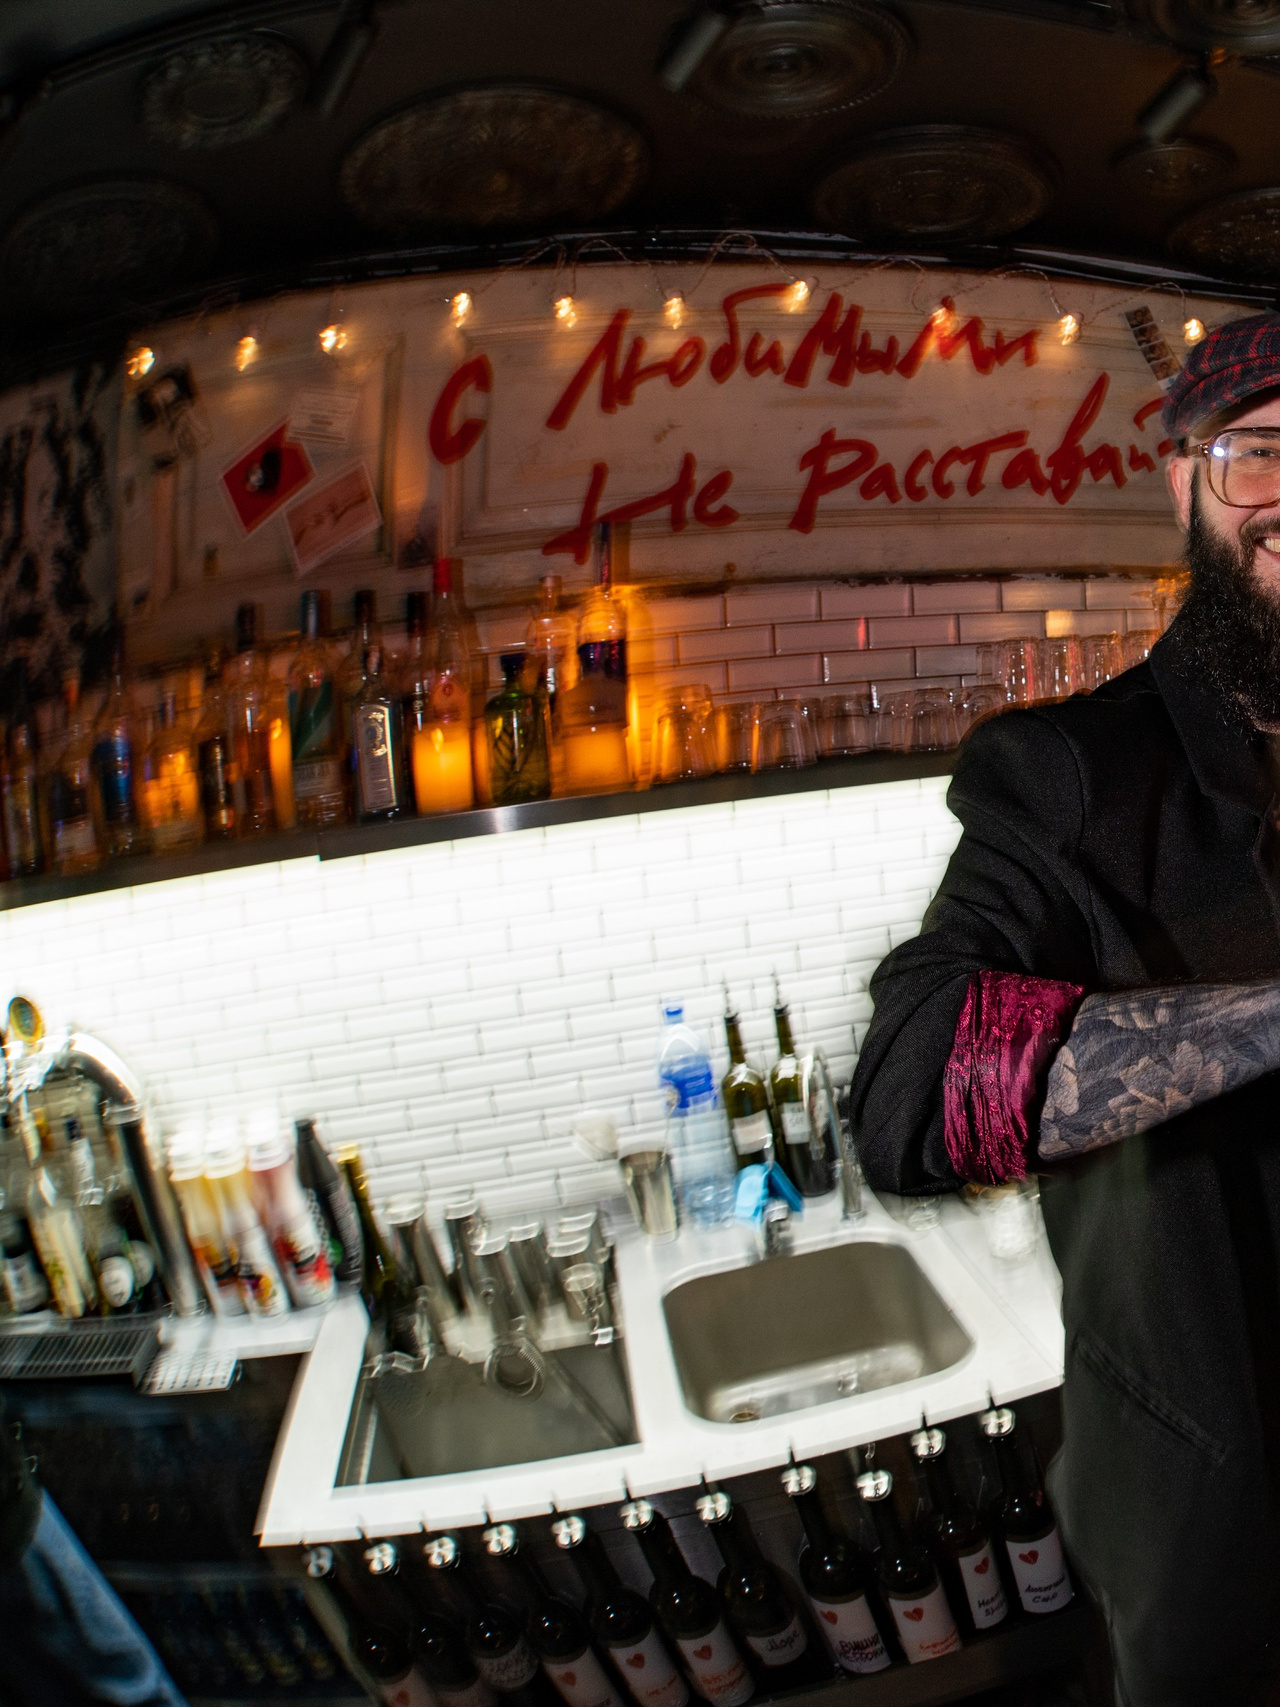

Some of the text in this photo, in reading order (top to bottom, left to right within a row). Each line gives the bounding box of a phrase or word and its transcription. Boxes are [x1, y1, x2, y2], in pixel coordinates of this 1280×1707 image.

[429, 354, 494, 465] С
[542, 372, 1178, 565] Не Расставай
